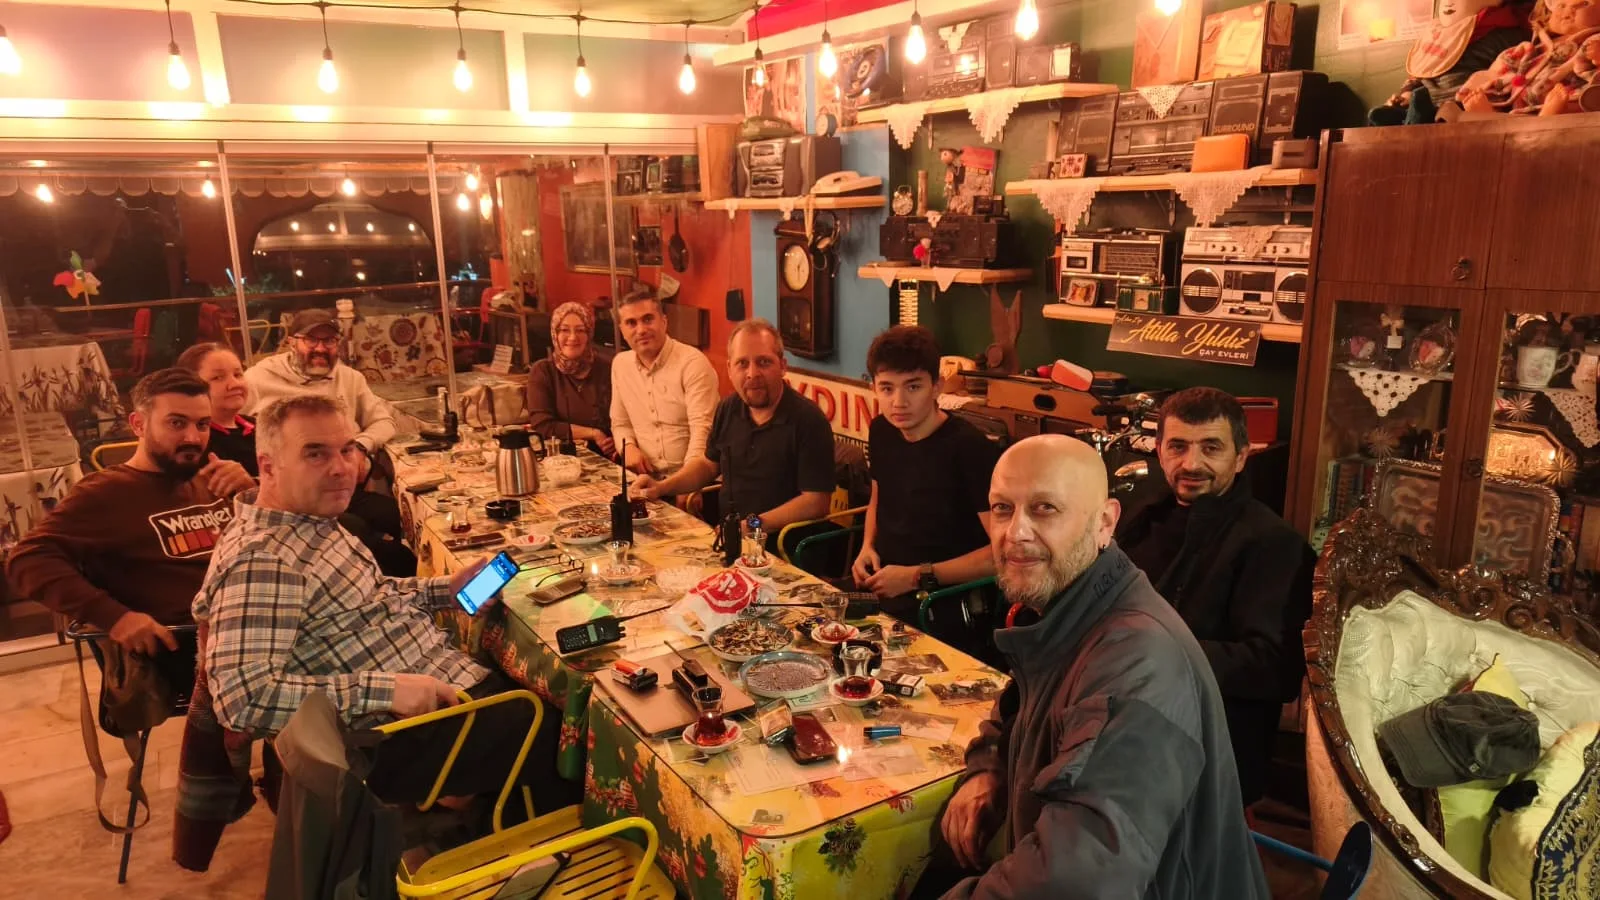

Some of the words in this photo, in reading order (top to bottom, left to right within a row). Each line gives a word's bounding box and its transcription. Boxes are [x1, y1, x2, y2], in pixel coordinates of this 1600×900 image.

[1120, 318, 1180, 343] Atilla
[1199, 348, 1216, 357] ÇAY
[1217, 350, 1250, 360] EVLERİ
[157, 507, 233, 535] Wrangler
